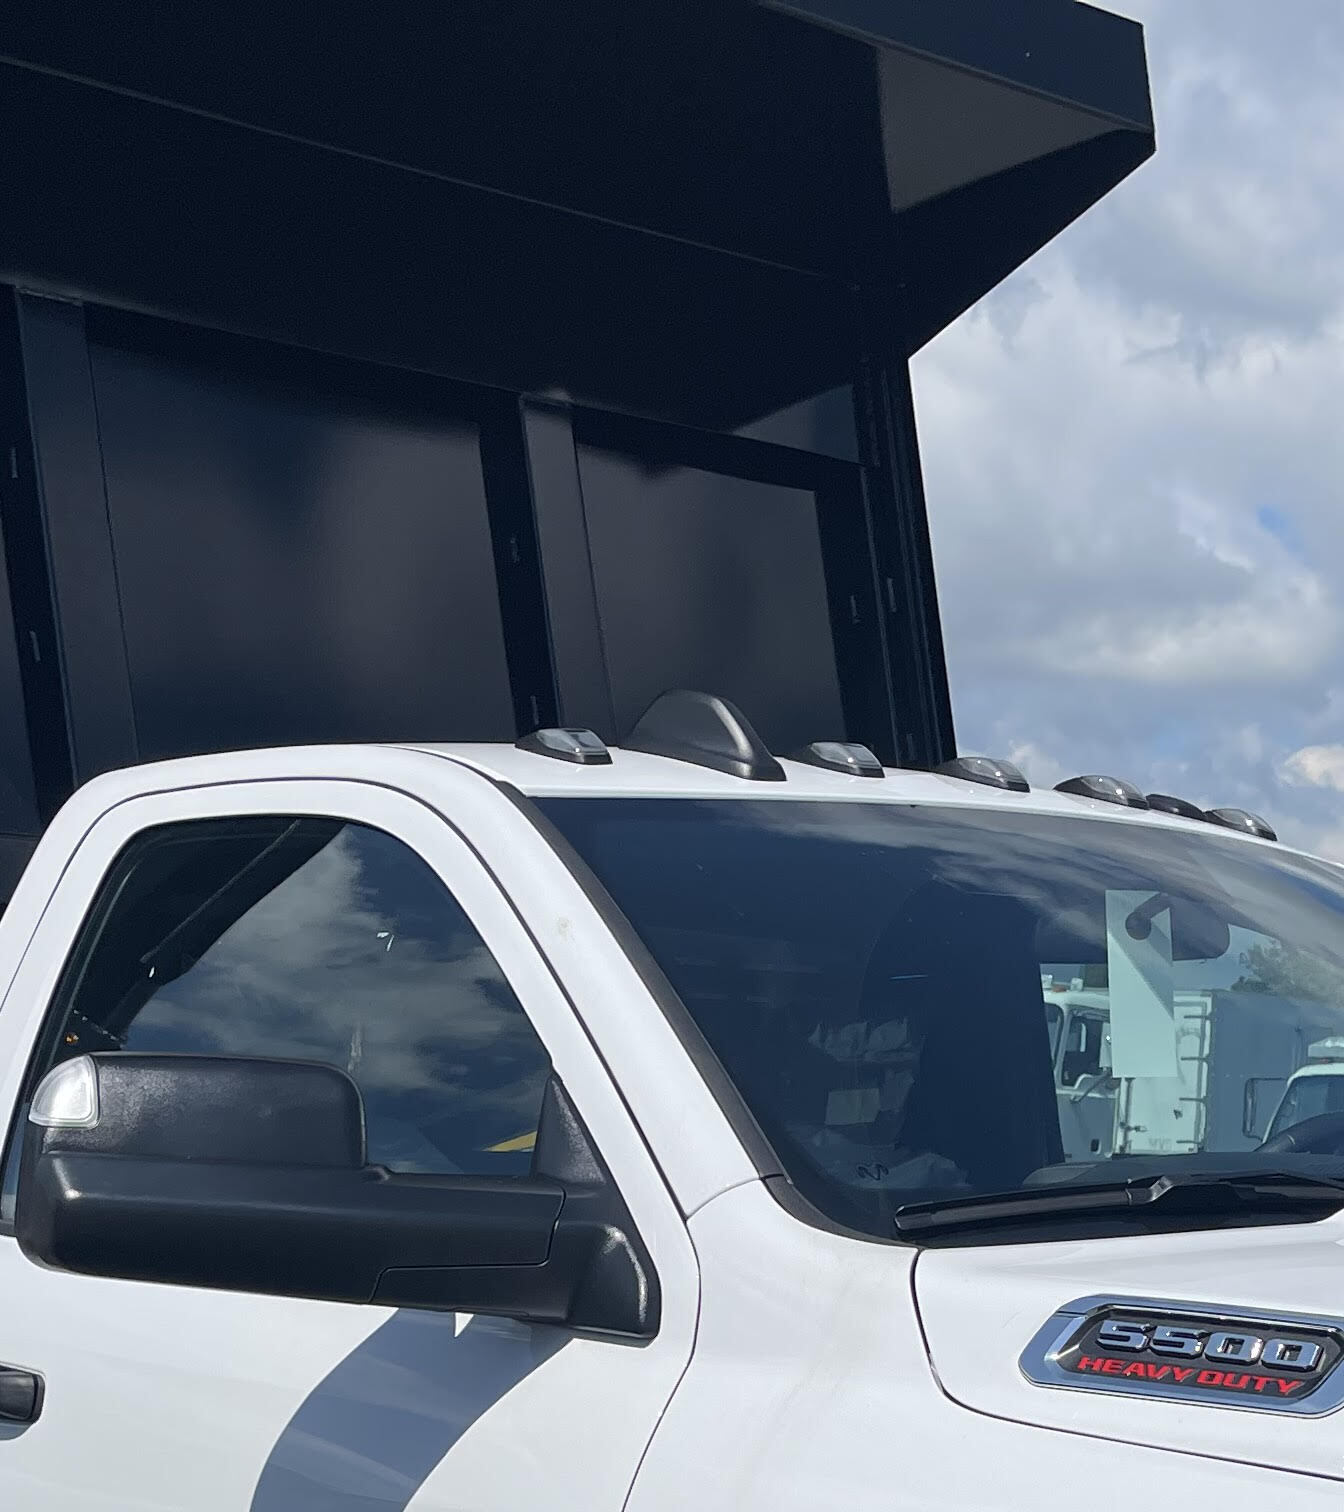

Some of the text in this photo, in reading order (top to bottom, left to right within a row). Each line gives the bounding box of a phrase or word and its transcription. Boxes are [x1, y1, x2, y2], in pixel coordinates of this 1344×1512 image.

[1094, 1319, 1326, 1373] 5500
[1076, 1355, 1306, 1397] HEAVY DUTY
